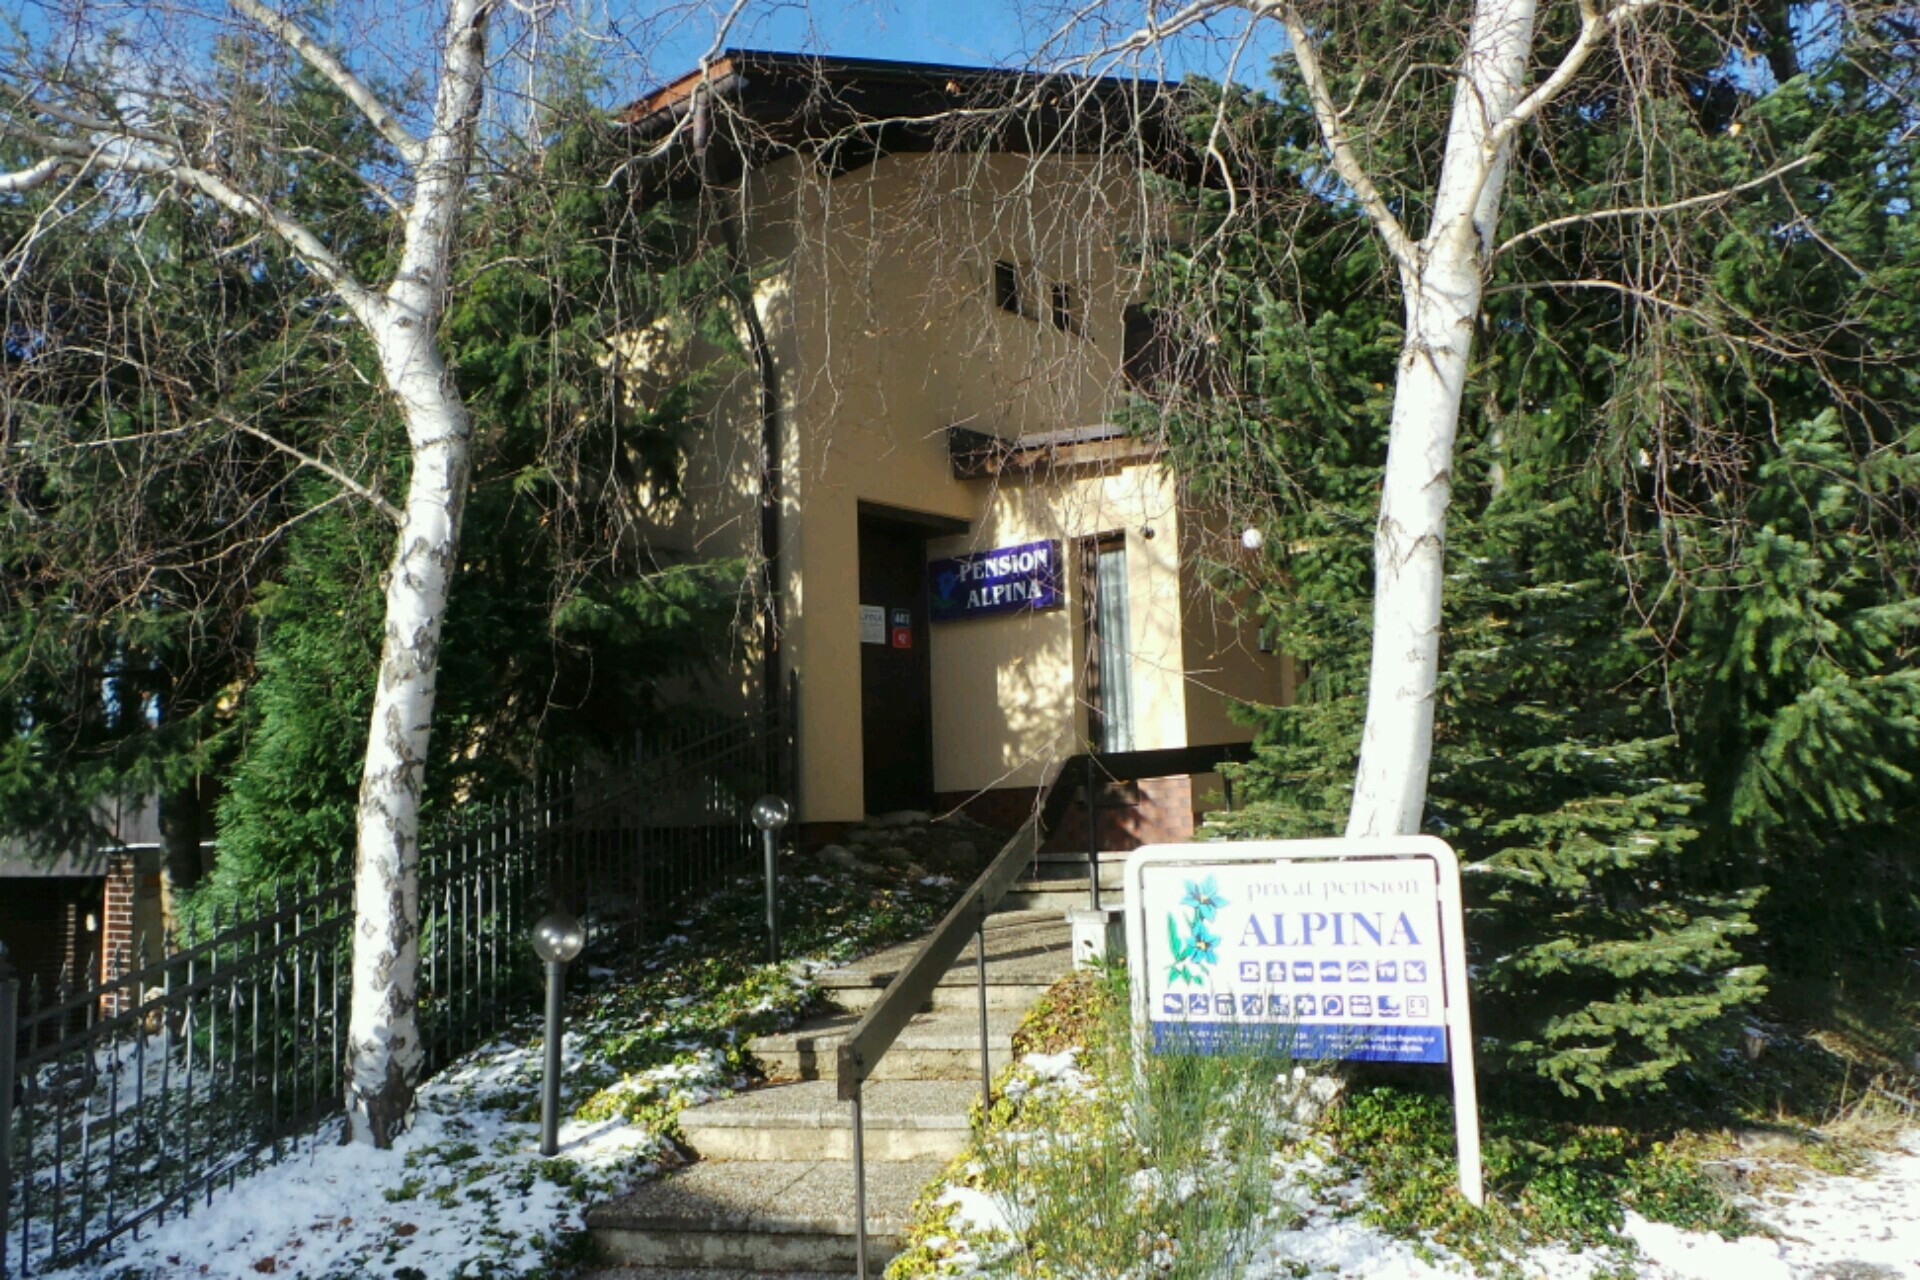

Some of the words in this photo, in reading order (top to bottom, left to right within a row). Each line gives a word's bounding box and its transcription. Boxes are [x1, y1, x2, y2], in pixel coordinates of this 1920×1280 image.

[959, 549, 1048, 582] PENSION
[966, 579, 1043, 609] ALPINA
[1247, 879, 1311, 902] privat
[1322, 878, 1420, 901] pension
[1238, 910, 1421, 947] ALPINA
